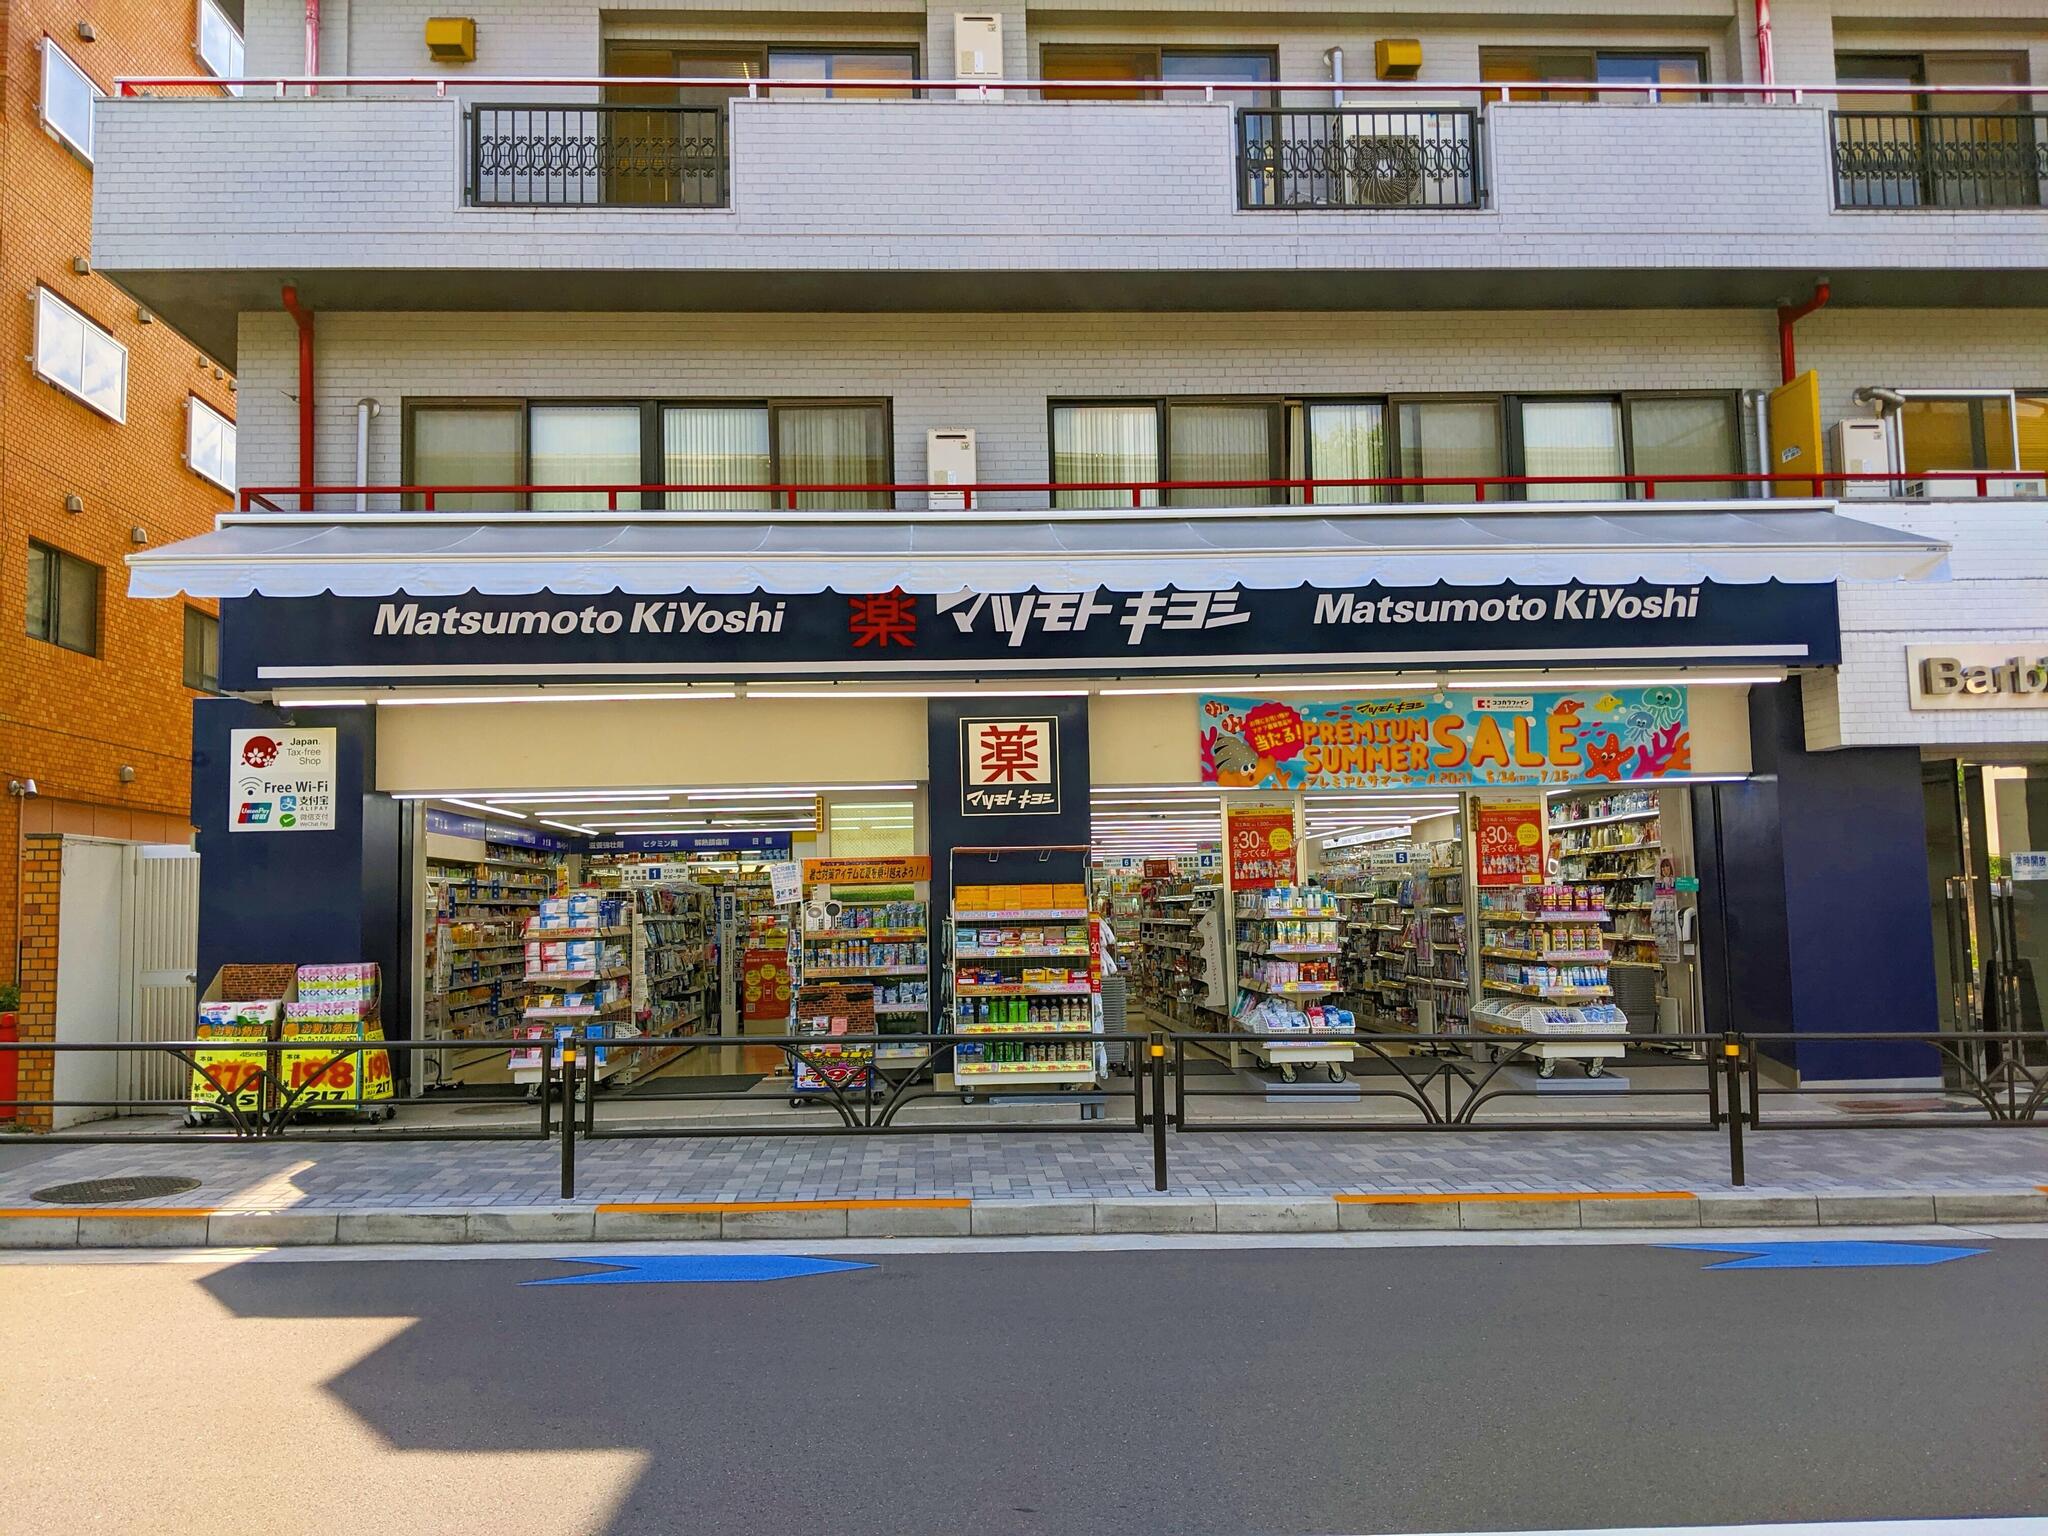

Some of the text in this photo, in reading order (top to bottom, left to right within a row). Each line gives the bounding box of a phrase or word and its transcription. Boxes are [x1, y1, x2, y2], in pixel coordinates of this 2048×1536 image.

[373, 602, 786, 635] Matsumoto KiYoshi
[1313, 587, 1700, 624] Matsumoto KiYoshi
[1919, 656, 2048, 694] Barb
[1303, 717, 1429, 745] PREMIUM
[1432, 714, 1582, 768] SALE
[287, 748, 321, 756] Tax-free
[299, 757, 321, 766] Shop
[980, 724, 1038, 783] 薬
[1303, 743, 1430, 775] SUMMER
[264, 781, 328, 793] Free Wi-Fi
[1399, 853, 1405, 862] 5
[291, 1061, 354, 1088] 198
